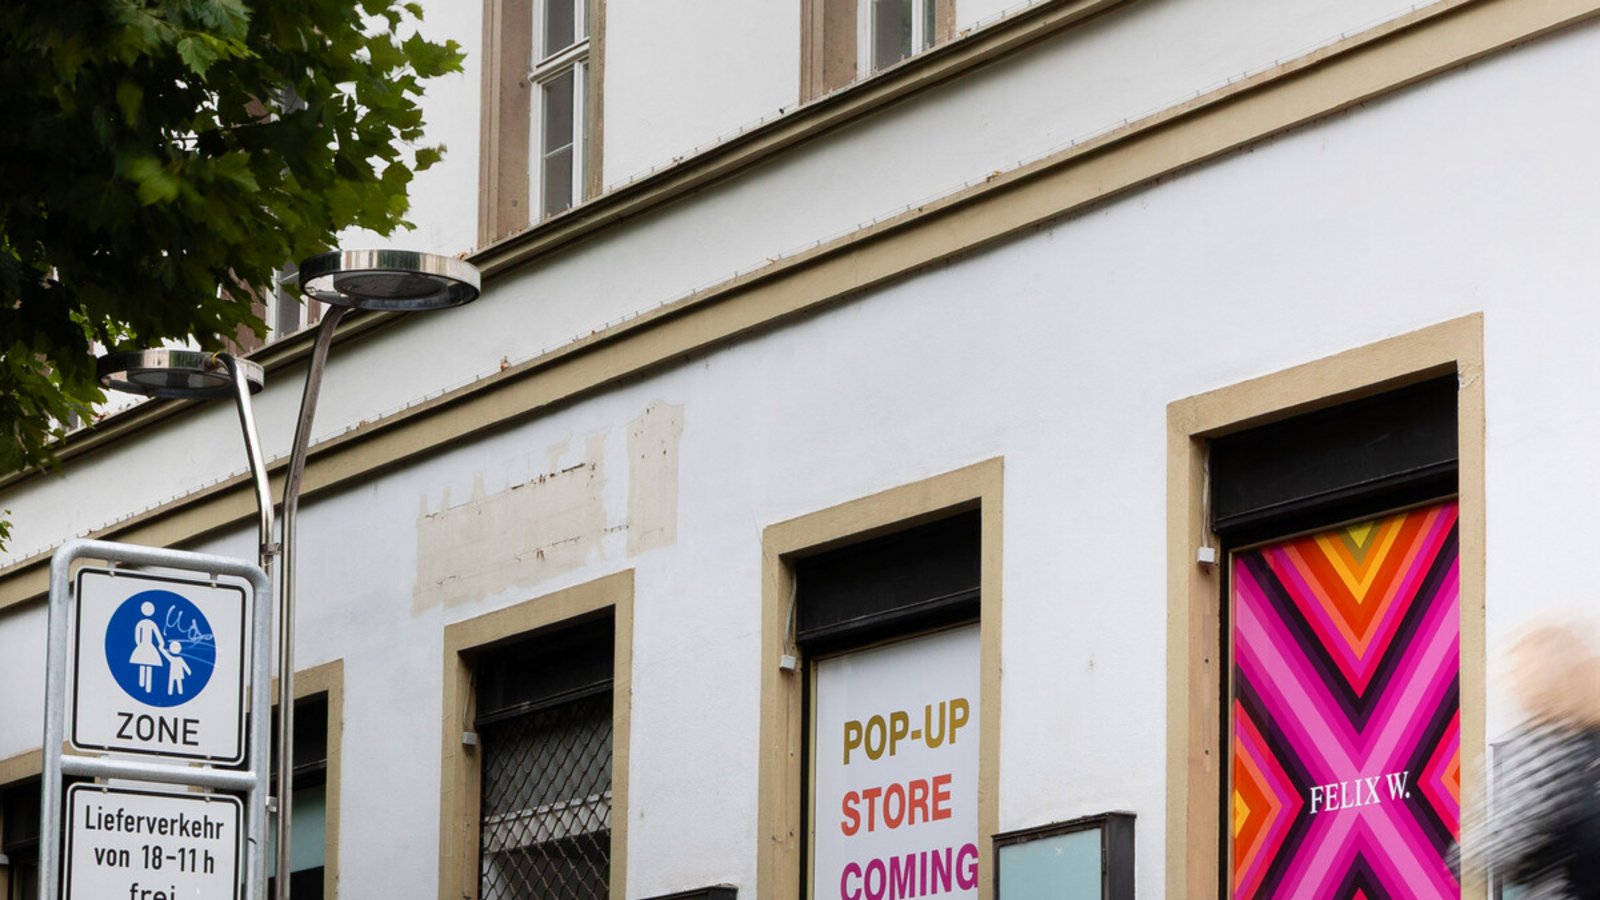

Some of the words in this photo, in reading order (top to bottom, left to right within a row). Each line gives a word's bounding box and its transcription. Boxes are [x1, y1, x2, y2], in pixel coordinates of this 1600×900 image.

[116, 712, 200, 746] ZONE
[843, 697, 970, 765] POP-UP
[841, 773, 952, 837] STORE
[1309, 775, 1381, 814] FELIX
[1385, 770, 1410, 801] W.
[85, 804, 224, 840] Lieferverkehr
[94, 847, 130, 868] von
[840, 843, 978, 900] COMING
